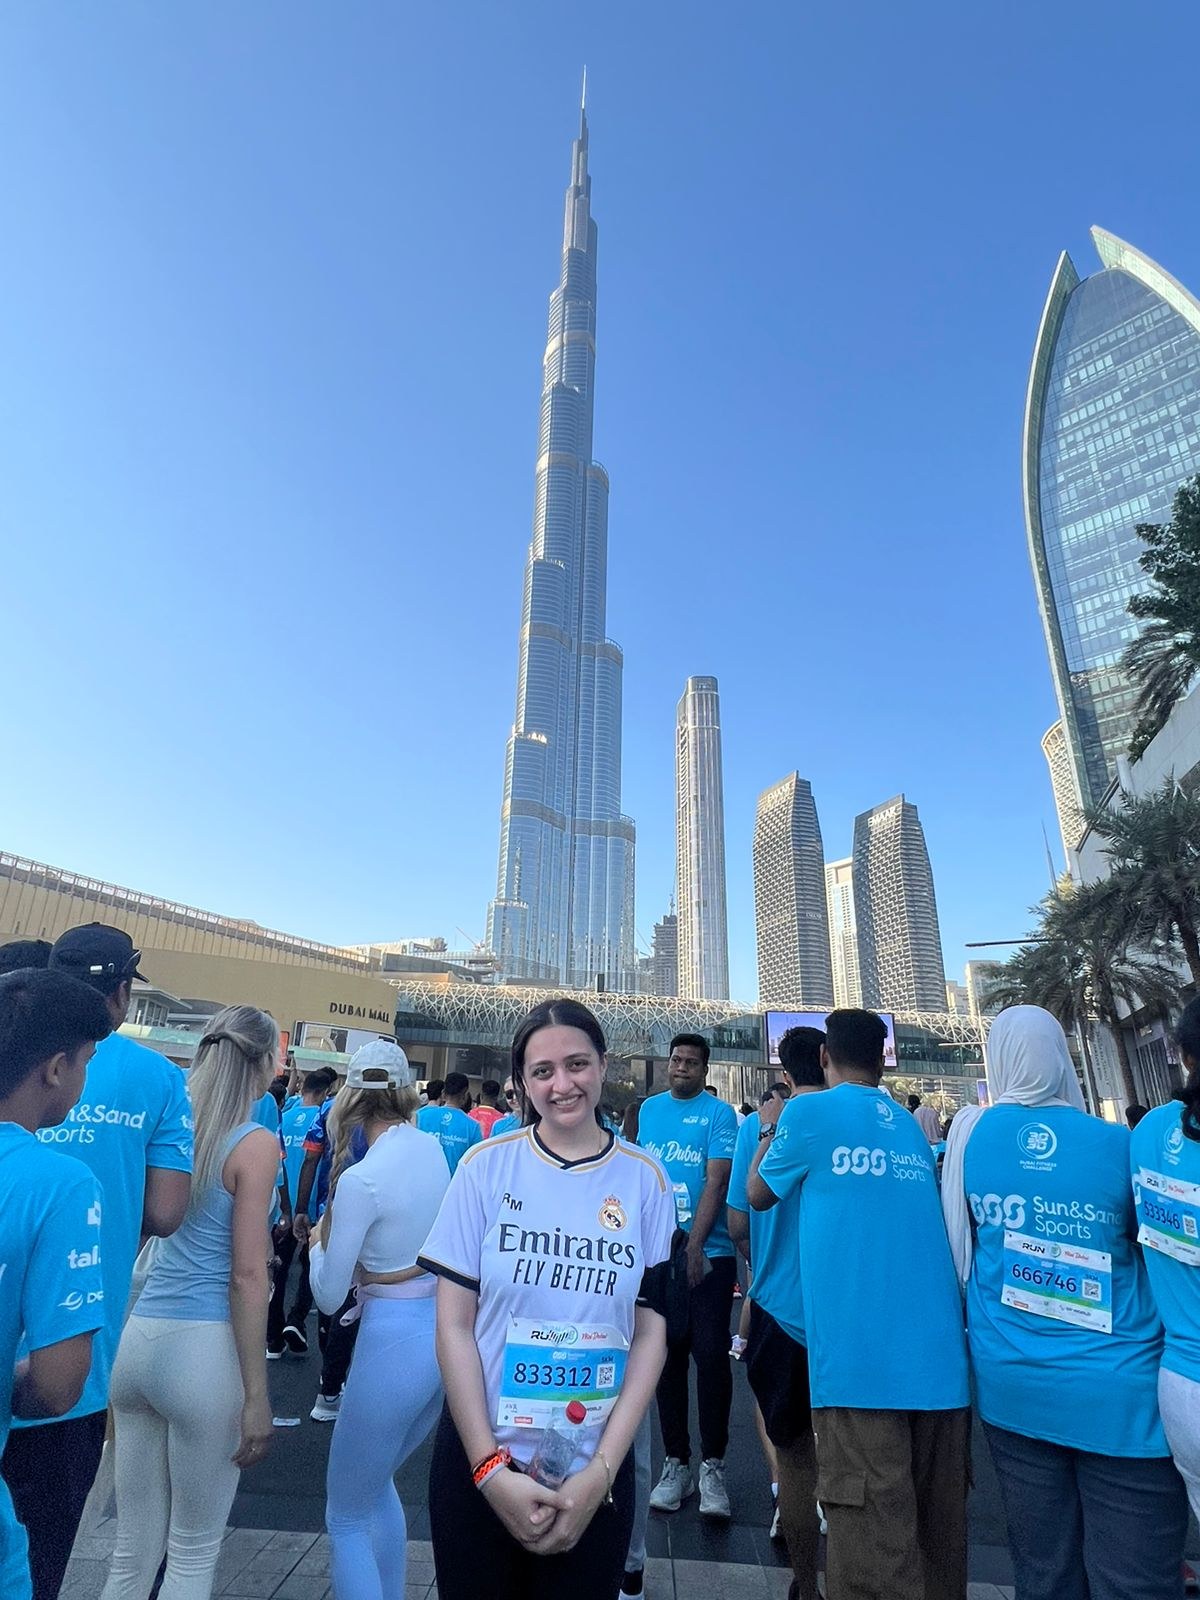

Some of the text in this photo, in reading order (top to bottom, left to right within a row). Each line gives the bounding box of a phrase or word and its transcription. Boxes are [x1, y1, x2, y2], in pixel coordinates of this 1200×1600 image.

[329, 1002, 390, 1023] DUBAI MALL
[665, 1140, 702, 1164] Dubai
[1034, 1214, 1092, 1239] Sports
[68, 1245, 101, 1269] tal
[499, 1223, 635, 1269] Emirates
[1022, 1242, 1046, 1254] RUN
[513, 1259, 617, 1296] FLY BETTER
[1012, 1263, 1077, 1293] 666746
[514, 1362, 592, 1387] 833312
